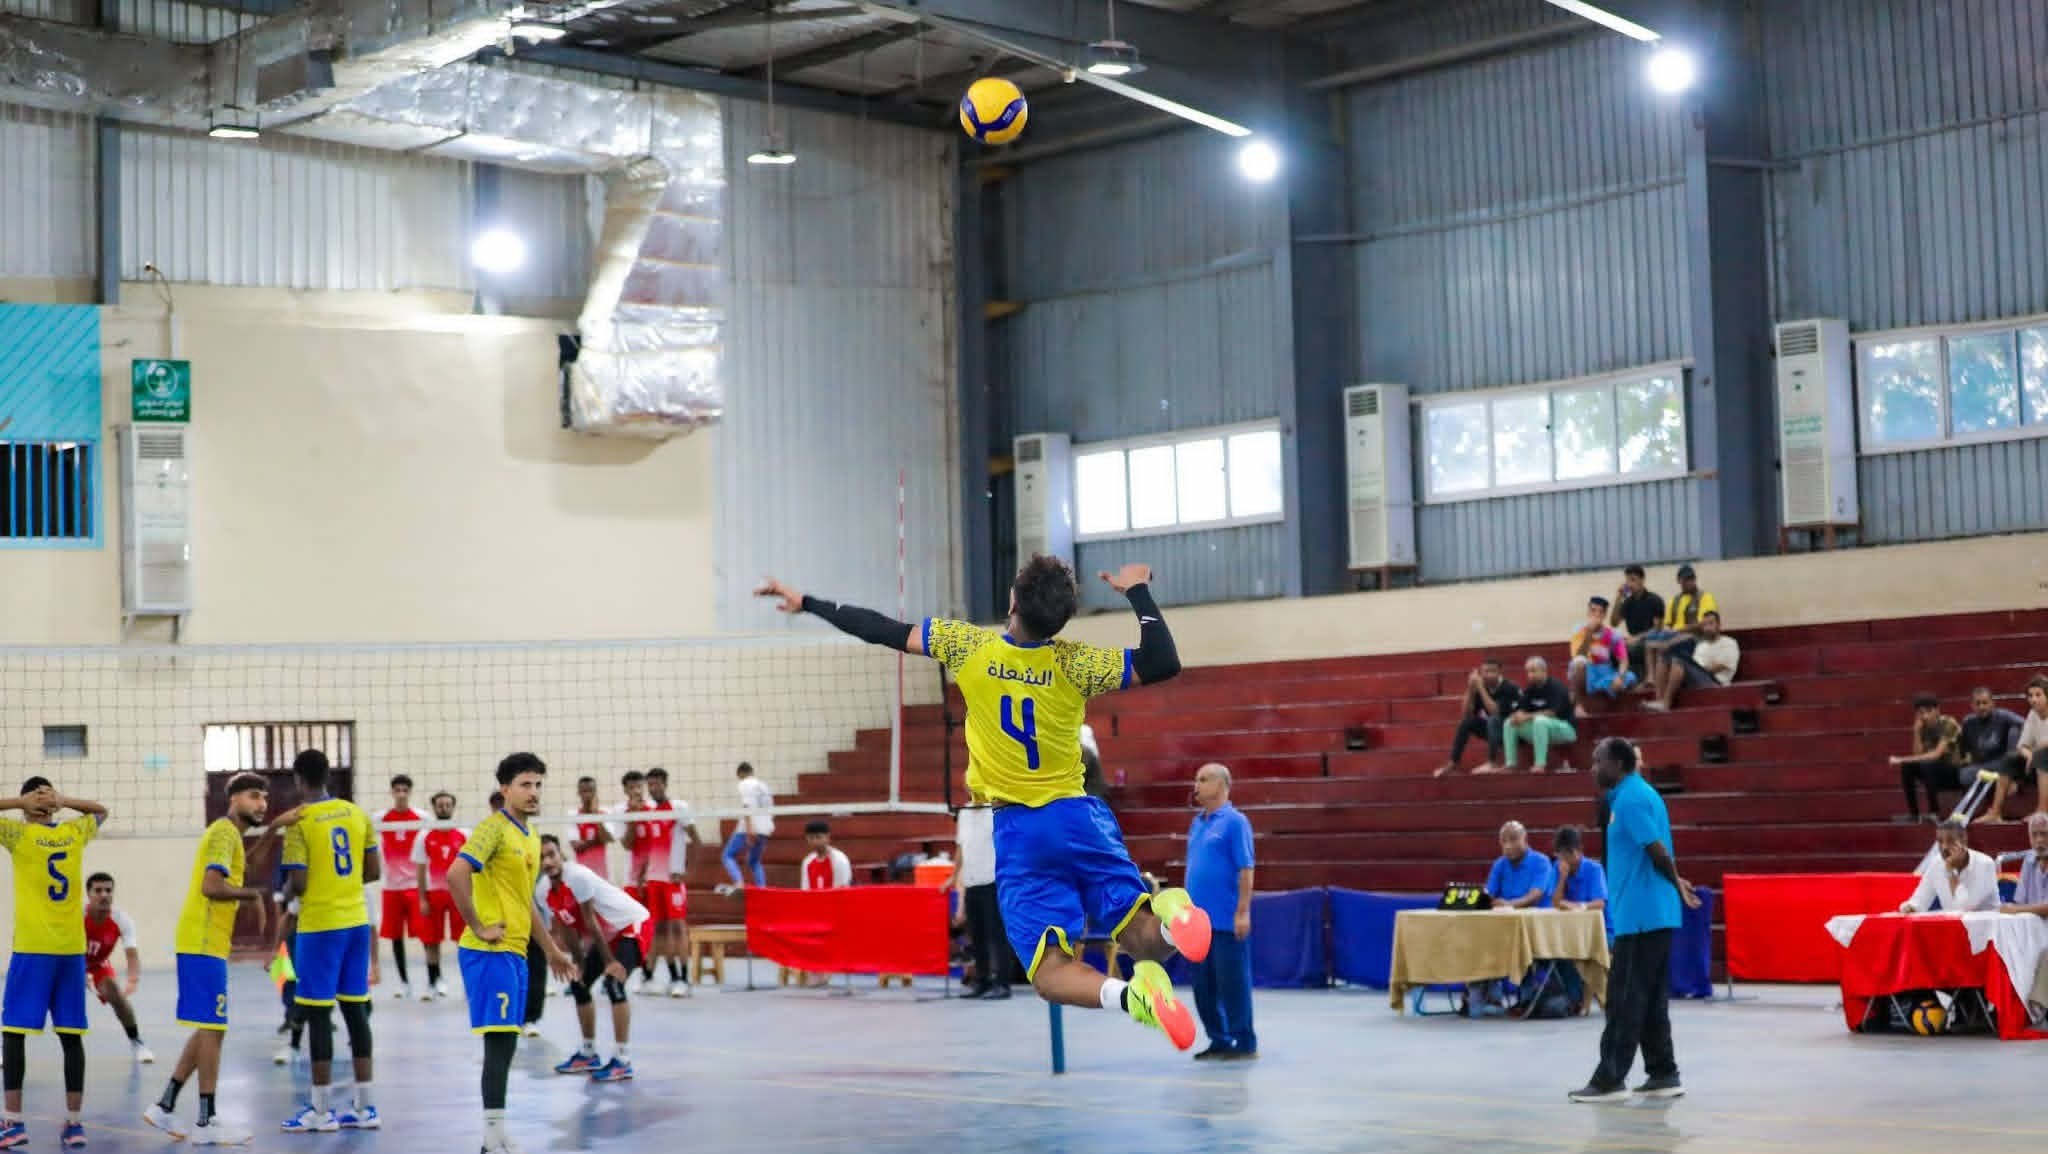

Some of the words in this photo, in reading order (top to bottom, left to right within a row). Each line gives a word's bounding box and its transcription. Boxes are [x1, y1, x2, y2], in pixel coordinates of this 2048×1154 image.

[987, 660, 1053, 687] الشعلة
[1000, 694, 1041, 771] 4
[47, 851, 69, 902] 5
[331, 826, 354, 877] 8
[495, 992, 510, 1020] 7
